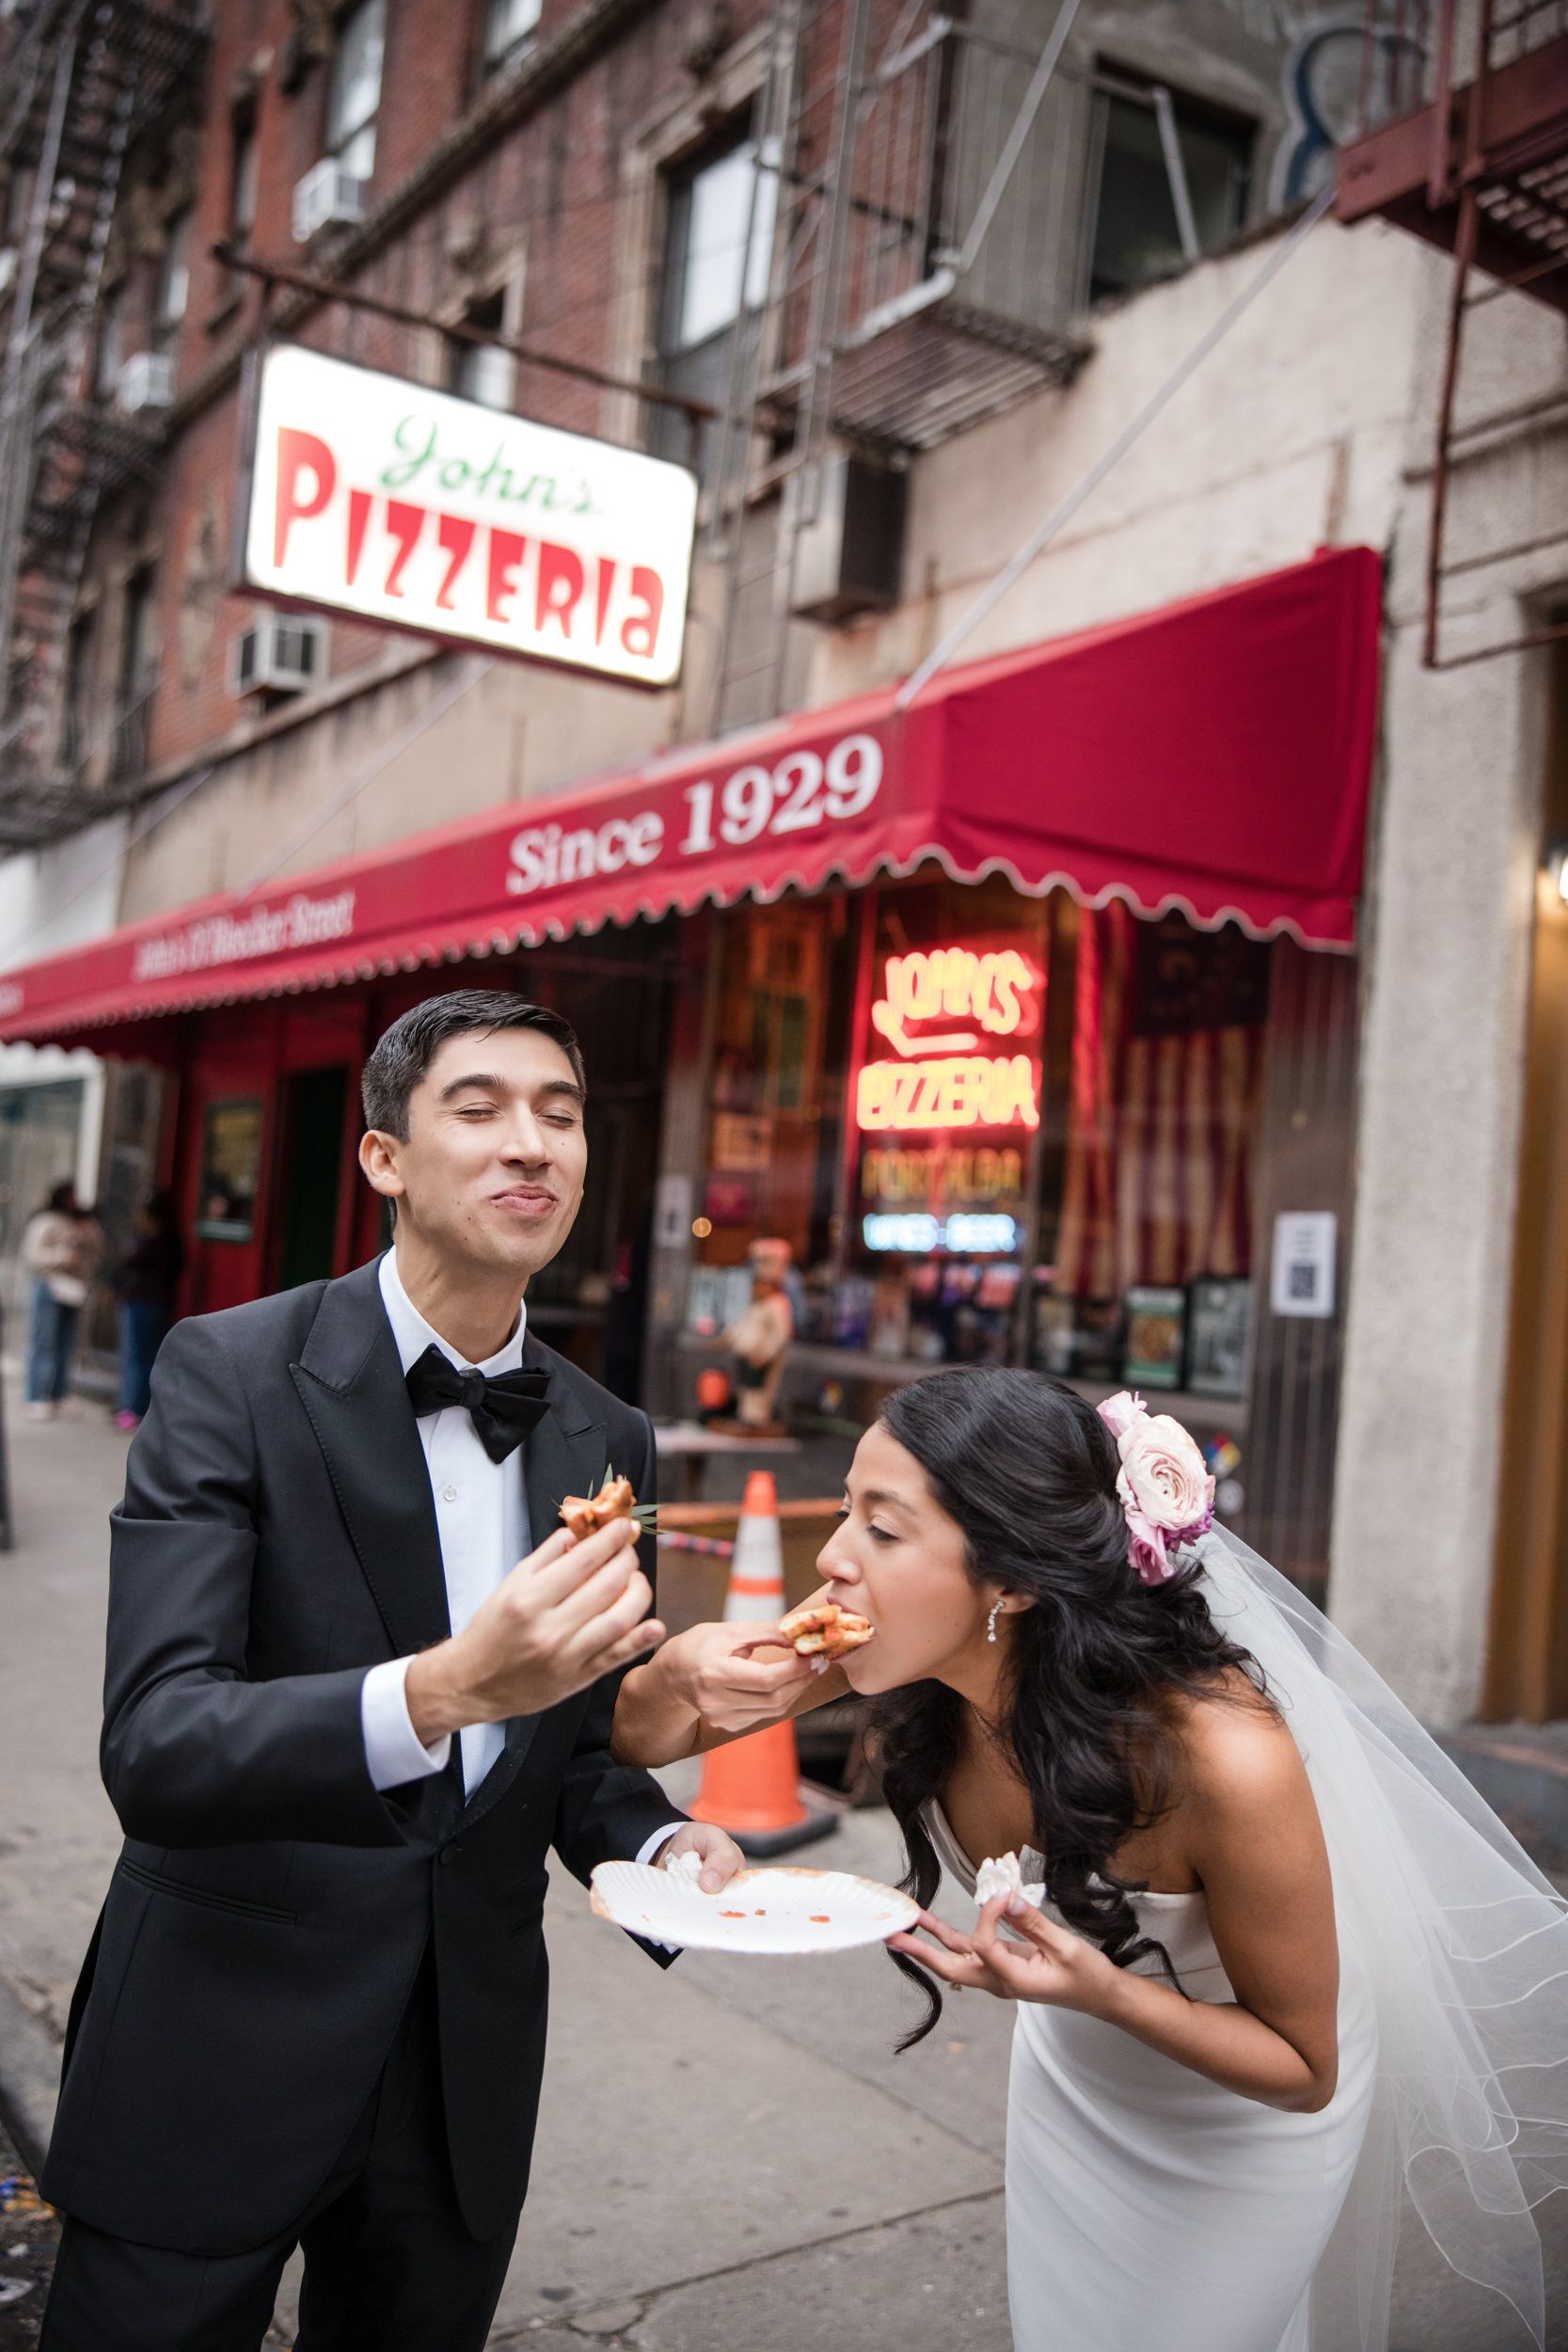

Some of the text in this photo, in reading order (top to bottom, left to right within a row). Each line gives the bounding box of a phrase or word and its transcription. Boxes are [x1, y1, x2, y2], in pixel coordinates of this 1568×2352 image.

[381, 412, 604, 516] John's
[505, 733, 884, 896] Since 1929
[857, 1055, 1040, 1131] PIZZERIA
